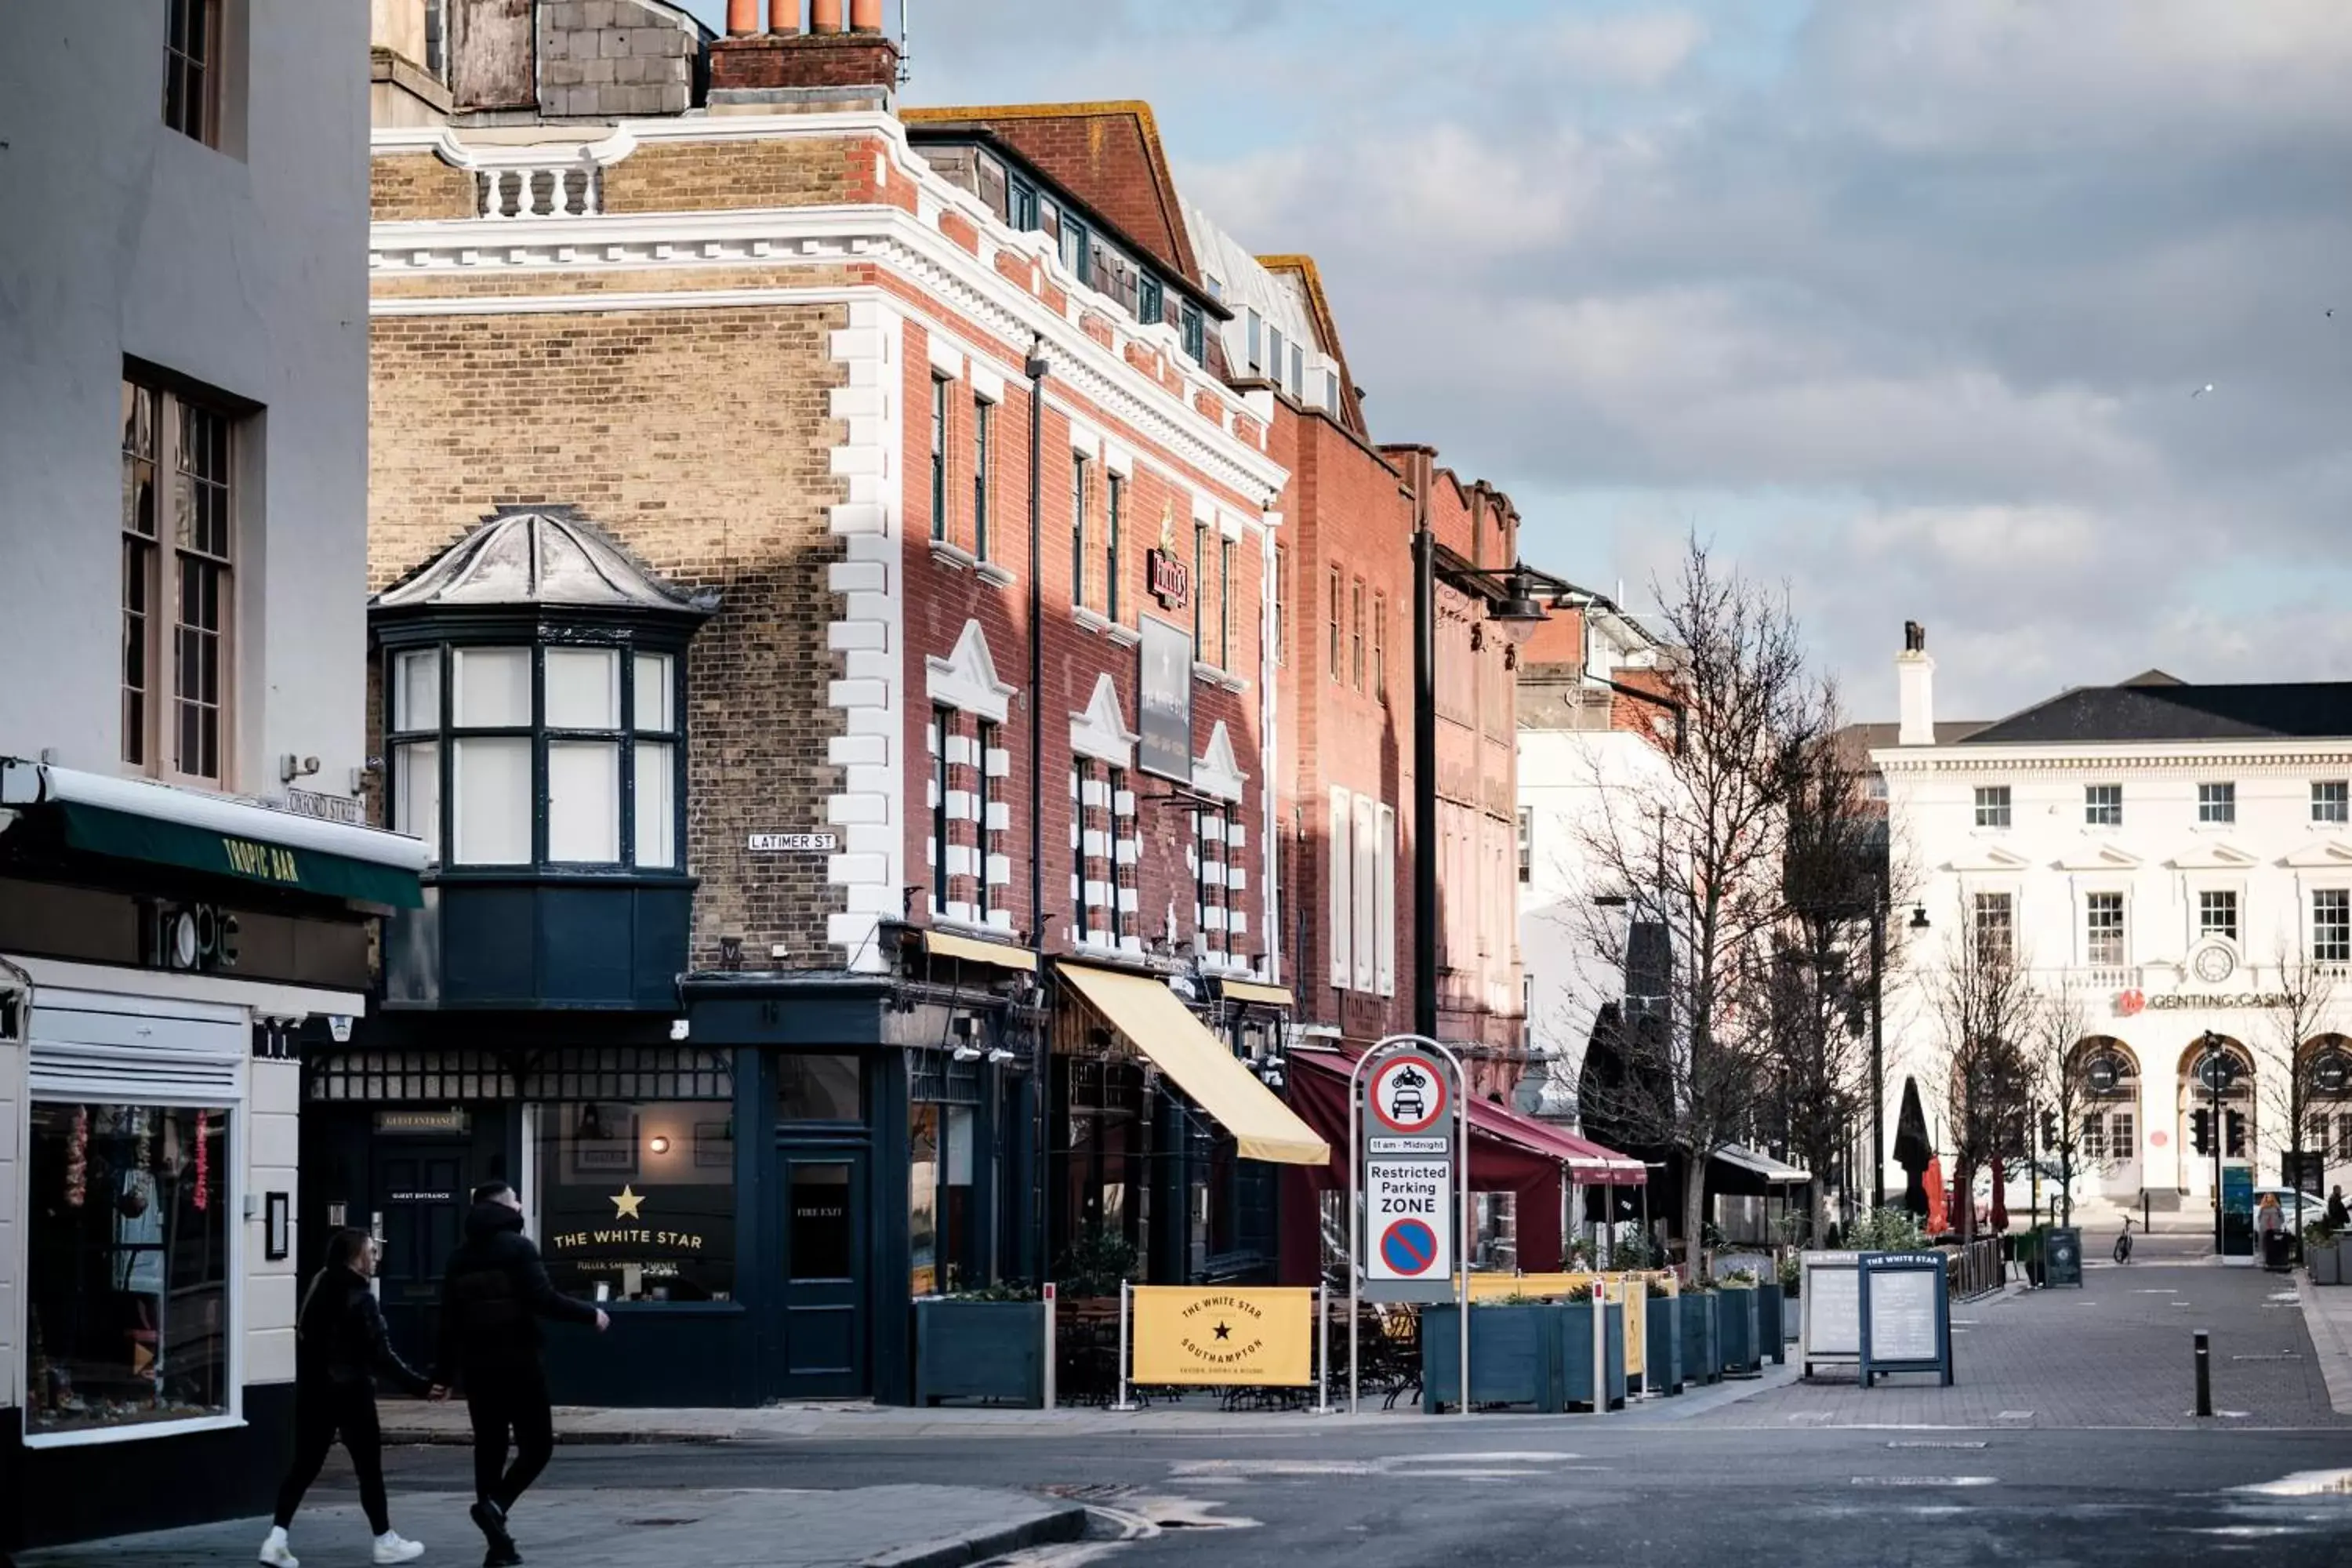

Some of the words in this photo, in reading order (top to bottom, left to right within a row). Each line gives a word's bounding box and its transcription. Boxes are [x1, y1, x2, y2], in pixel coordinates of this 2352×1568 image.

[752, 835, 809, 848] LATIMER
[815, 835, 831, 847] ST
[222, 838, 269, 878] TROPIC
[271, 848, 299, 882] BAR
[2152, 993, 2234, 1008] GENTING
[2238, 993, 2307, 1009] CASINO
[1403, 1141, 1443, 1150] Midnight
[1371, 1166, 1446, 1178] Restricted
[1382, 1181, 1436, 1196] Parking
[1381, 1199, 1436, 1213] ZONE
[553, 1232, 588, 1249] THE
[594, 1229, 651, 1243] WHITE
[657, 1232, 702, 1249] STAR
[1867, 1257, 1884, 1266] THE
[1886, 1254, 1914, 1264] WHITE
[1916, 1255, 1939, 1265] STAR
[1181, 1302, 1201, 1319] THE
[1202, 1296, 1236, 1308] WHITE
[1238, 1300, 1262, 1319] STAR
[1181, 1338, 1264, 1364] SOUTHAMPTON
